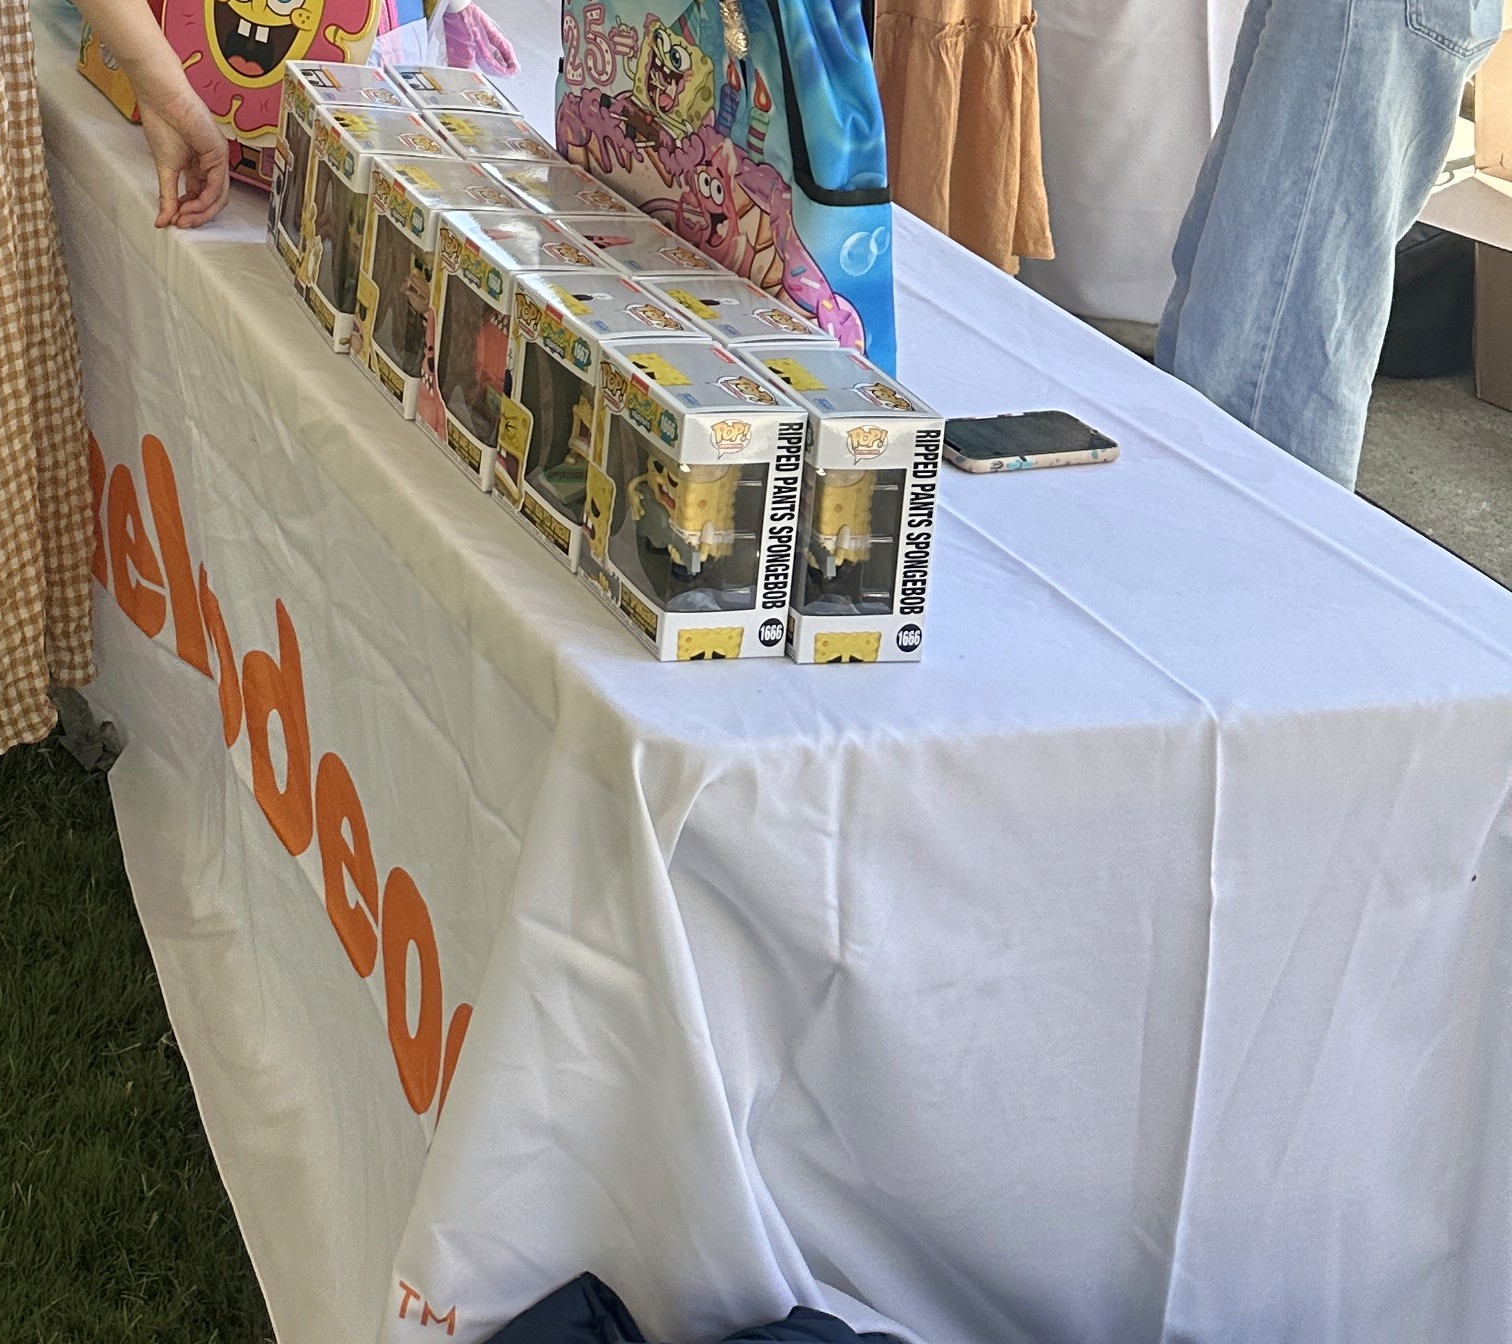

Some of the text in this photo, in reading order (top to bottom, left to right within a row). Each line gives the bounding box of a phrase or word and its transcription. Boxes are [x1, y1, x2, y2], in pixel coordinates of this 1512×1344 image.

[563, 3, 617, 87] 25
[761, 422, 804, 610] RIPPED PANTS SPONGEBOB
[899, 429, 941, 616] RIPPED PANTS SPONGEBOB
[760, 623, 783, 642] 1666
[897, 629, 921, 647] 1666
[398, 1280, 456, 1336] TM
